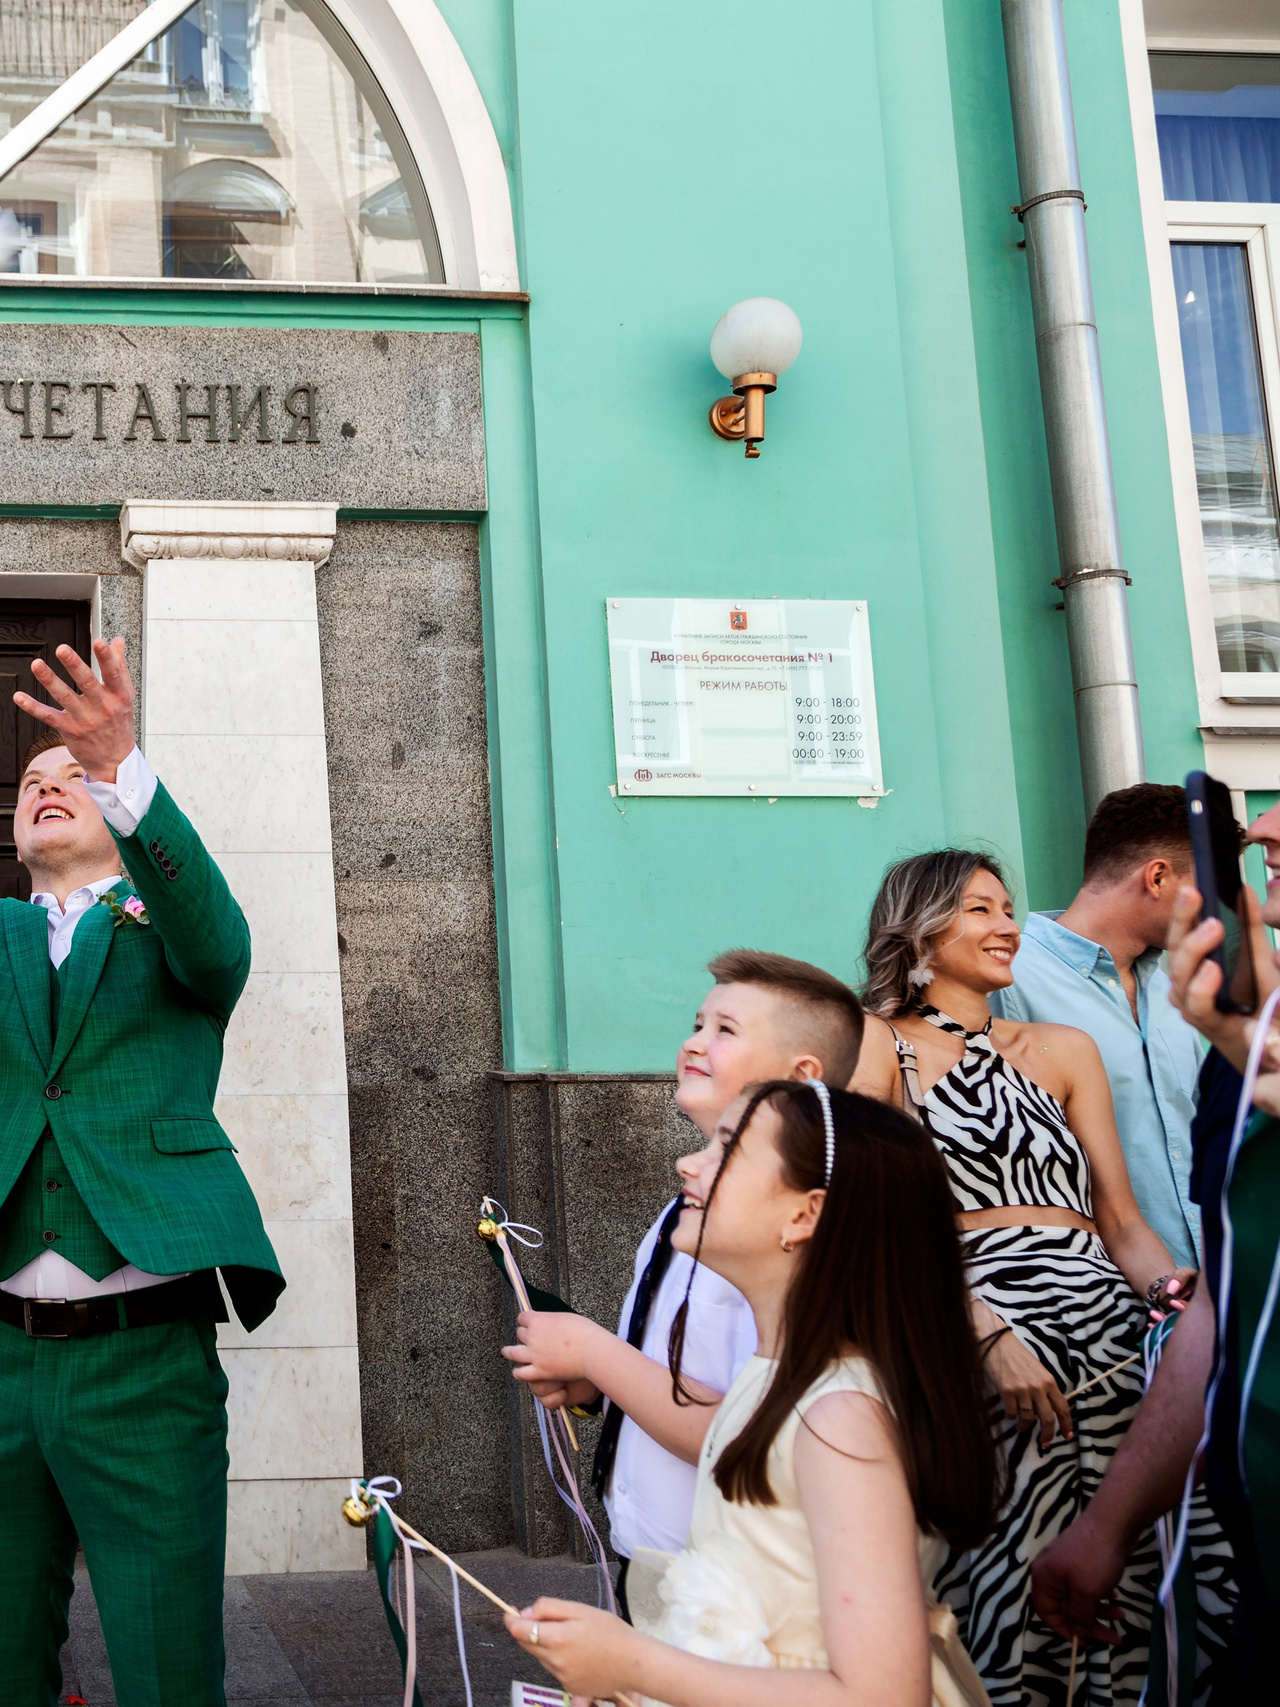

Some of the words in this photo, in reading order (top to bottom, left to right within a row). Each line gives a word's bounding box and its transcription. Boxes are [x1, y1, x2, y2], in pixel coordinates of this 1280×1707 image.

[650, 651, 699, 664] Дворец
[702, 651, 805, 664] бракосочетания
[828, 652, 833, 663] 1
[700, 680, 742, 691] РЕЖИМ
[744, 681, 788, 691] РАБОТЫ
[795, 697, 820, 708] 9:00
[831, 697, 860, 708] 18:00
[796, 714, 822, 724] 9:00
[830, 714, 862, 724] 20:00
[798, 731, 823, 741] 9:00
[831, 731, 863, 741] 23:59
[792, 748, 824, 759] 00:00
[835, 748, 865, 759] 19:00
